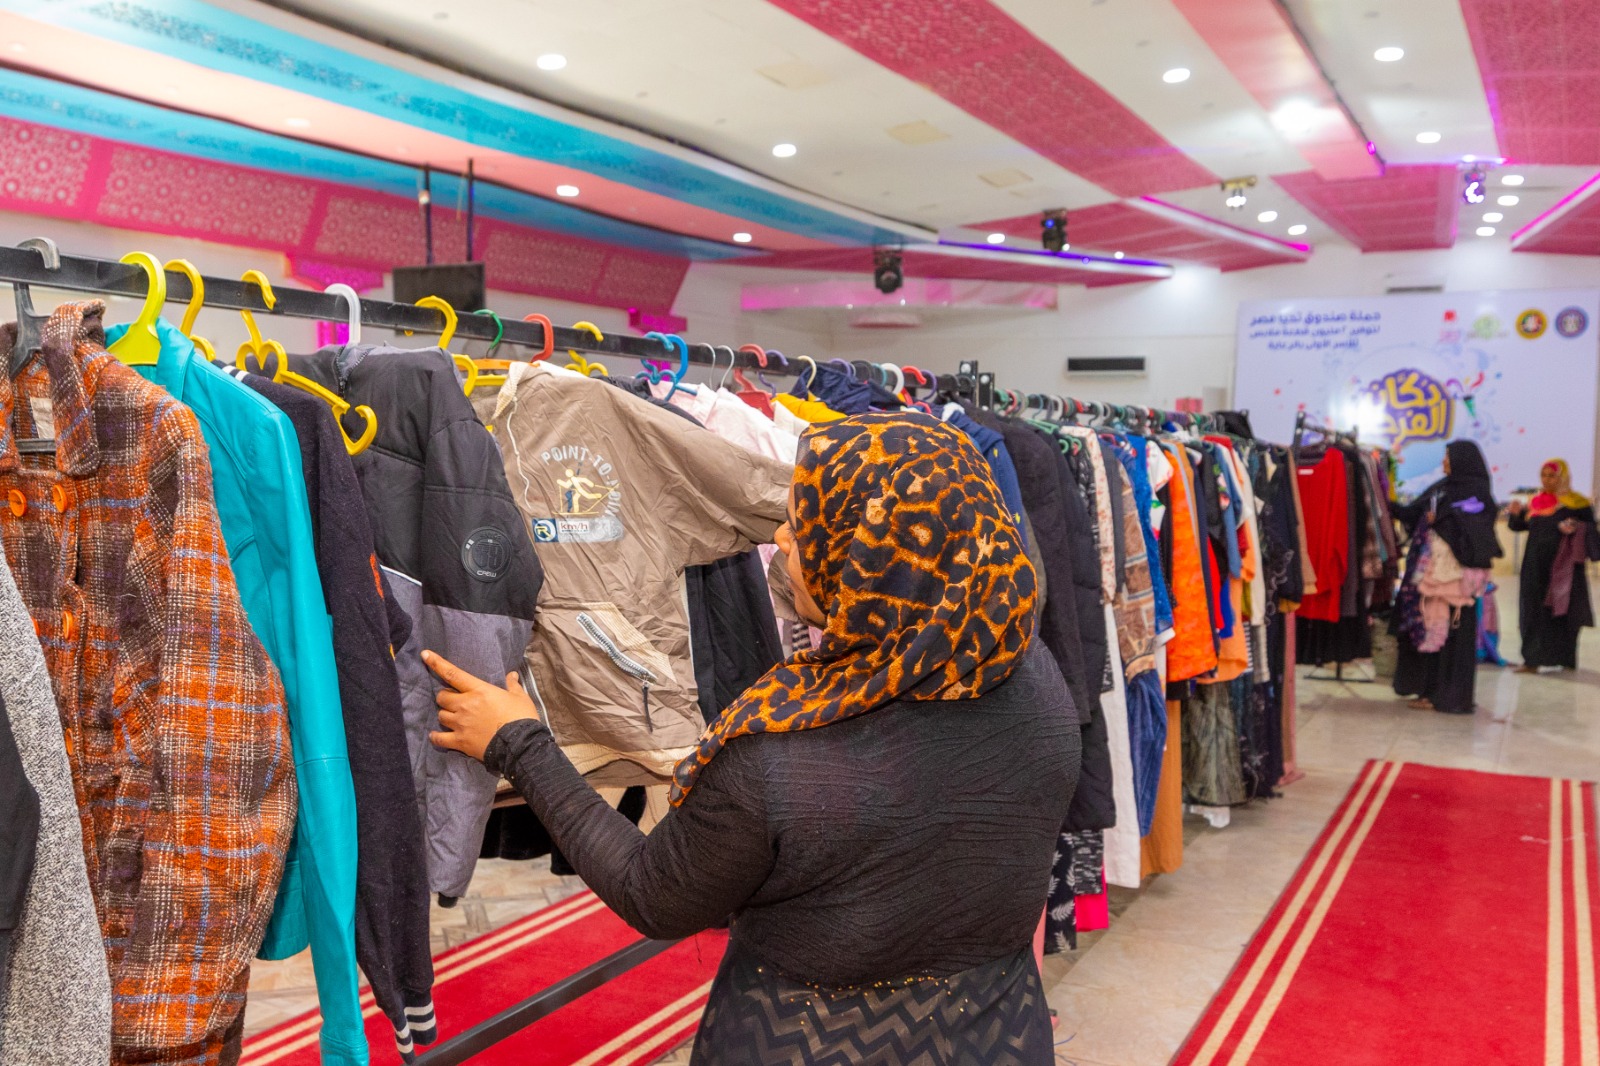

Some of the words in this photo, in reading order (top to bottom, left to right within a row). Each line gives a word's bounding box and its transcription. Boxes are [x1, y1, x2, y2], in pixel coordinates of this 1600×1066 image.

[1250, 315, 1276, 326] مصر
[1304, 312, 1347, 324] صندوق
[1349, 310, 1381, 321] حملة
[560, 521, 588, 531] km/h
